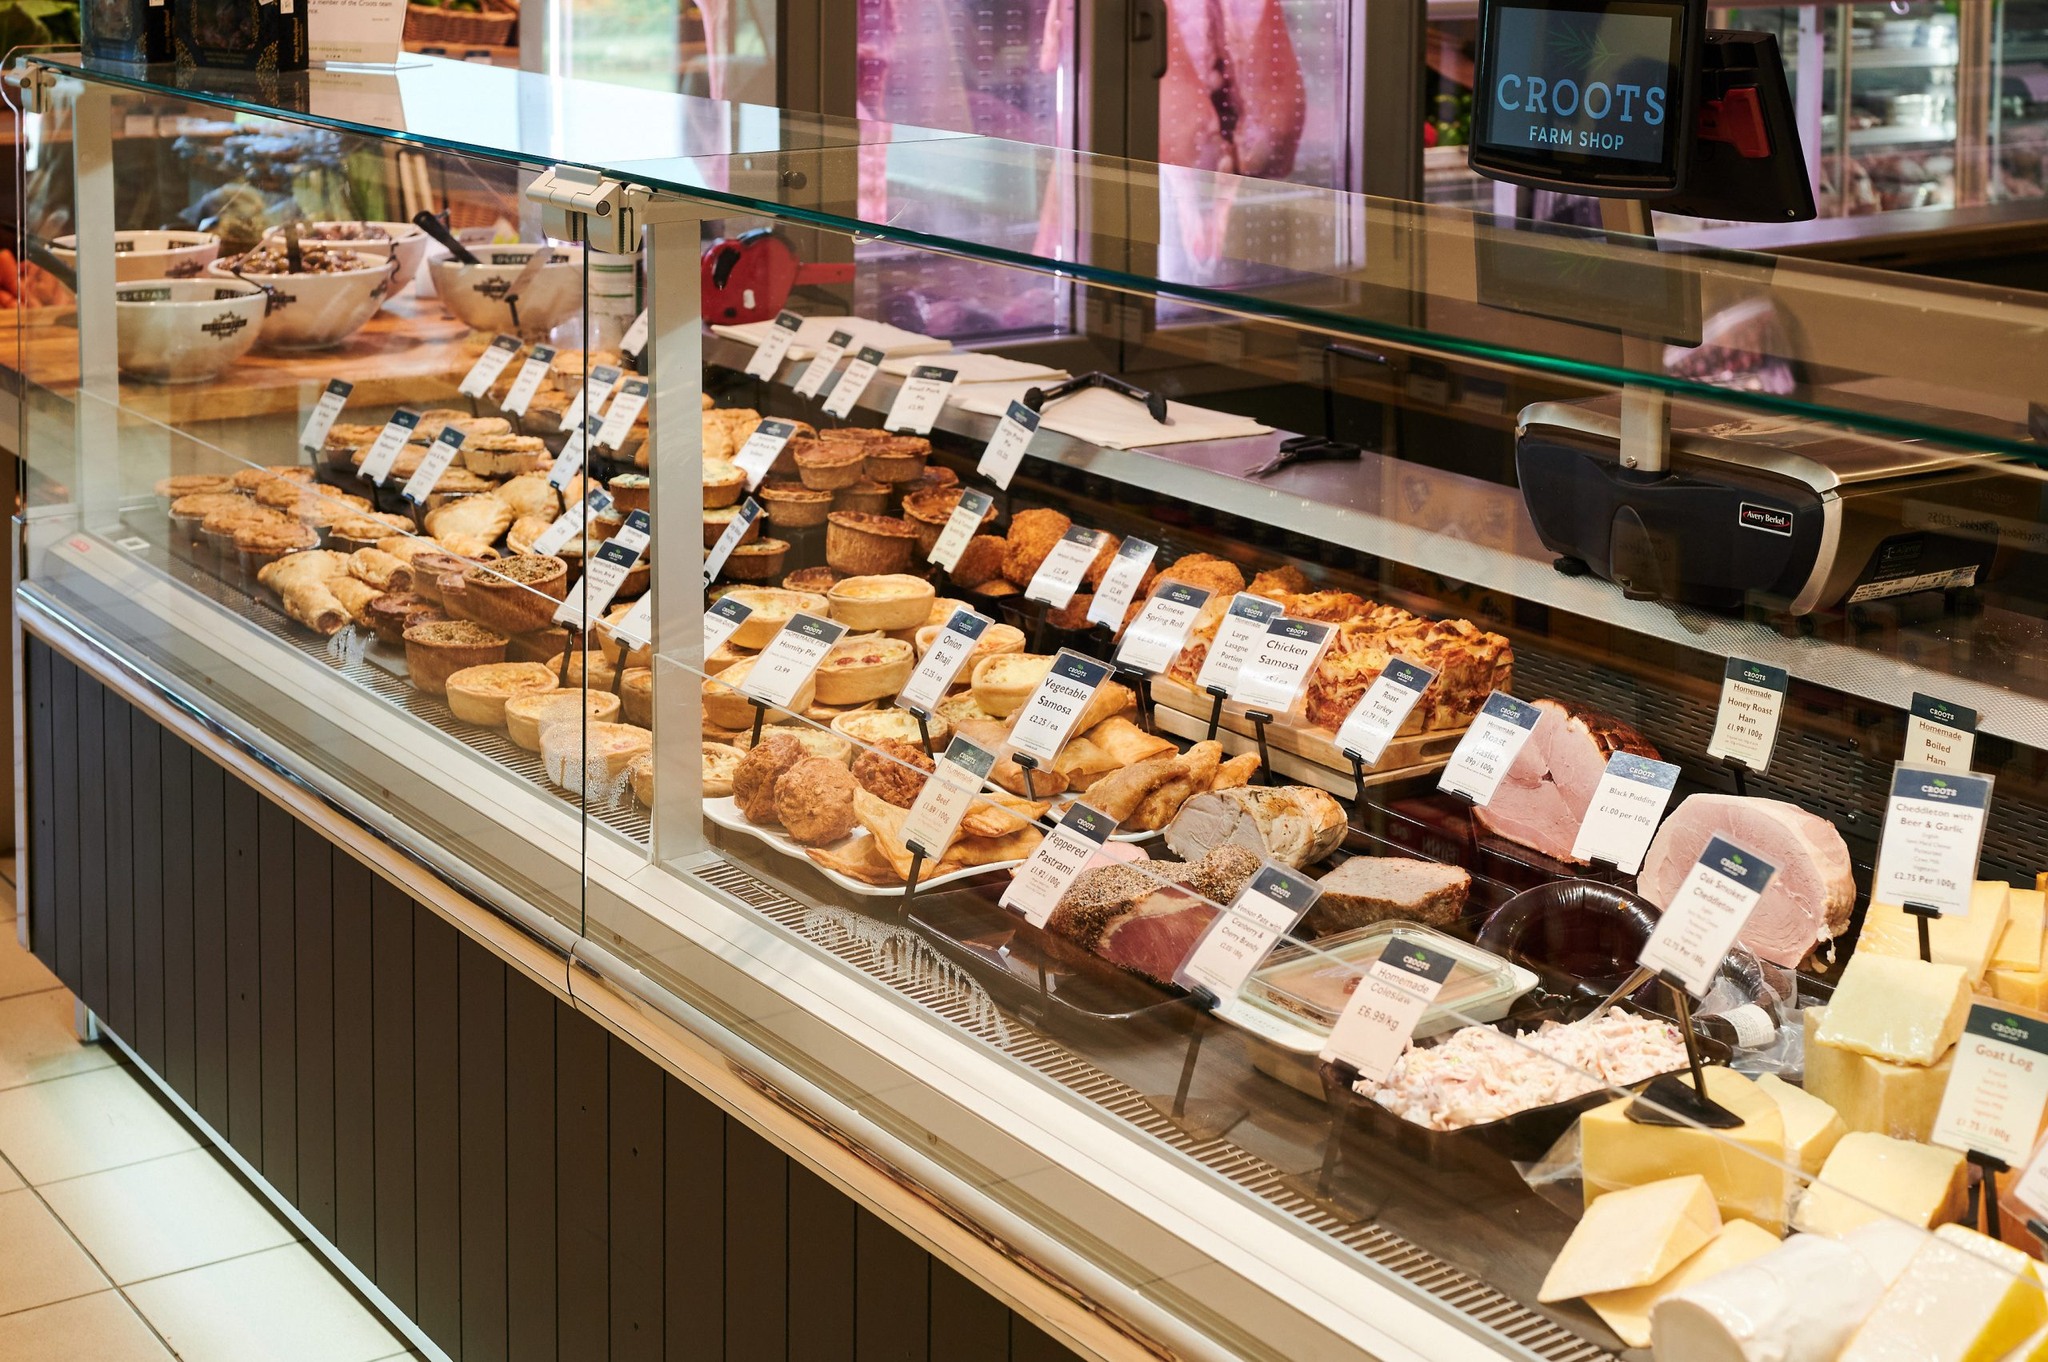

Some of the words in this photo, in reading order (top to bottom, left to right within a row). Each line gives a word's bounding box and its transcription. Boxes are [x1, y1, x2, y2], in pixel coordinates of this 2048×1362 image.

[1497, 73, 1665, 125] CROOTS
[1529, 126, 1572, 145] FARM
[1579, 131, 1624, 150] SHOP
[1746, 511, 1764, 522] Avery
[1765, 514, 1785, 525] Berkel
[608, 551, 623, 560] CROOTS
[1172, 592, 1191, 600] CROOTS
[1157, 603, 1184, 615] Chinese
[1244, 607, 1263, 618] CROOTS
[959, 622, 972, 631] CROOTS
[1146, 612, 1168, 625] Spring
[1169, 619, 1184, 628] Roll
[802, 624, 823, 635] CROOTS
[1232, 630, 1249, 640] Large
[1286, 627, 1308, 636] CROOTS
[785, 631, 815, 646] HOMEMADE
[943, 635, 962, 650] Onion
[779, 640, 805, 654] Homity
[806, 648, 816, 658] Pie
[1224, 641, 1248, 653] Lasagne
[1266, 640, 1308, 656] Chicken
[935, 651, 953, 666] Bhaji
[1221, 651, 1242, 663] Portion
[1258, 654, 1299, 671] Samosa
[1068, 666, 1087, 677] CROOTS
[1397, 671, 1414, 682] CROOTS
[1744, 670, 1766, 681] CROOTS
[1044, 678, 1088, 701] Vegetable
[1382, 691, 1399, 703] Roast
[1734, 683, 1772, 700] Homemade
[1038, 695, 1072, 715] Samosa
[1373, 701, 1393, 716] Turkey
[1728, 697, 1751, 710] Honey
[1753, 704, 1773, 715] Roast
[1029, 714, 1047, 726] £2.25
[1500, 707, 1520, 719] CROOTS
[1738, 713, 1756, 725] Ham
[1929, 707, 1955, 720] CROOTS
[1488, 721, 1515, 736] Homemade
[1748, 728, 1763, 741] 100g
[1920, 721, 1962, 741] Homemade
[1482, 731, 1507, 747] Roast
[1926, 739, 1951, 753] Boiled
[960, 752, 976, 764] CROOTS
[1926, 754, 1946, 766] Ham
[1480, 762, 1494, 774] 100g
[1629, 767, 1656, 778] CROOTS
[1609, 787, 1627, 798] Black
[1629, 792, 1657, 807] Pudding
[1921, 785, 1957, 797] CROOTS
[935, 794, 950, 806] Beef
[939, 810, 950, 824] 100g
[1599, 805, 1619, 816] £1.00
[1634, 813, 1651, 826] 100g
[1896, 803, 1950, 817] Cheddleton
[1953, 812, 1974, 820] with
[1077, 818, 1095, 831] CROOTS
[1900, 817, 1922, 826] Beer
[1935, 822, 1964, 834] Garlic
[1048, 832, 1088, 858] Peppered
[1037, 850, 1075, 876] Pastrami
[1720, 857, 1748, 876] CROOTS
[1048, 874, 1060, 888] 100g
[1894, 872, 1917, 881] £2.75
[1919, 875, 1934, 884] Per
[1937, 879, 1957, 890] 100g
[1270, 884, 1291, 898] CROOTS
[1232, 917, 1258, 936] Cranberry
[1221, 926, 1240, 942] Cherry
[1240, 937, 1259, 952] Brandy
[1403, 955, 1431, 970] CROOTS
[1377, 968, 1429, 994] Homemade
[1370, 982, 1411, 1004] Coleslaw
[1358, 1005, 1400, 1031] £6.99/kg
[1991, 1022, 2030, 1040] CROOTS
[1975, 1044, 2006, 1062] Goat
[2009, 1052, 2034, 1072] Log
